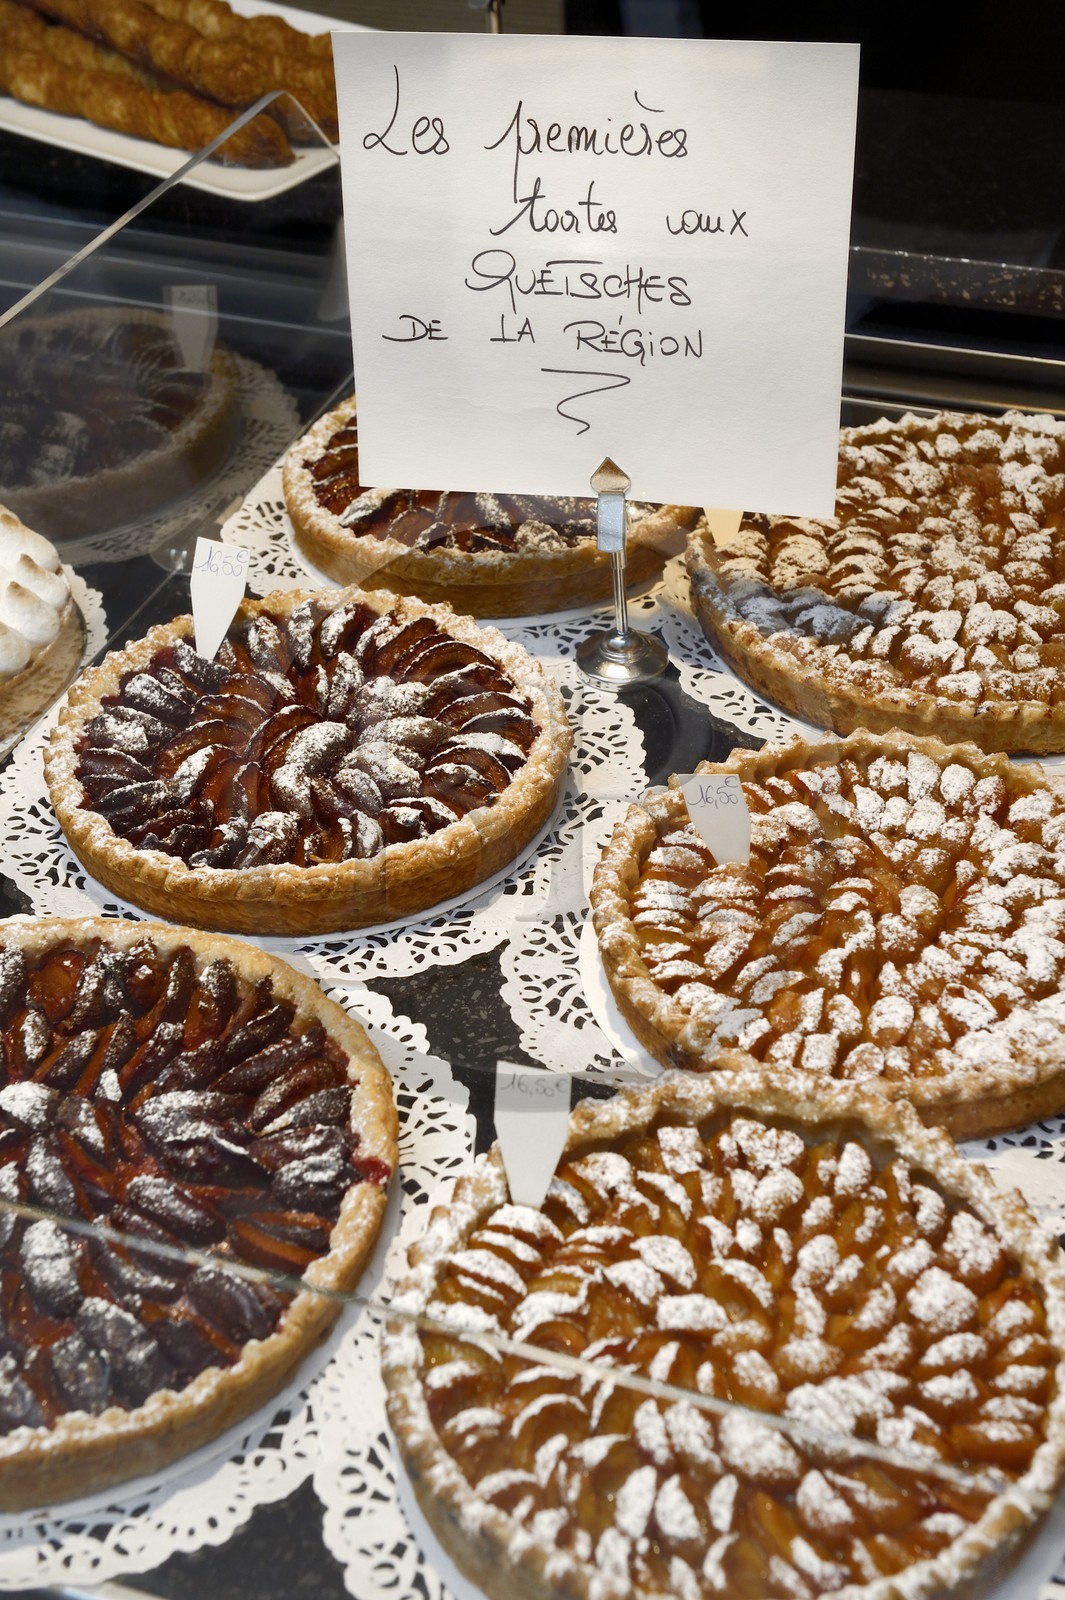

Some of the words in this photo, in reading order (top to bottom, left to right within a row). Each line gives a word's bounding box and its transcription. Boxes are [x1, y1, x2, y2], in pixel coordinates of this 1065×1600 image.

[363, 65, 450, 156] Les
[484, 90, 688, 204] premières
[490, 177, 618, 236] tartes
[667, 208, 749, 237] aux
[465, 249, 692, 315] QUETSCHES
[382, 315, 449, 342] DE
[490, 314, 536, 343] LA
